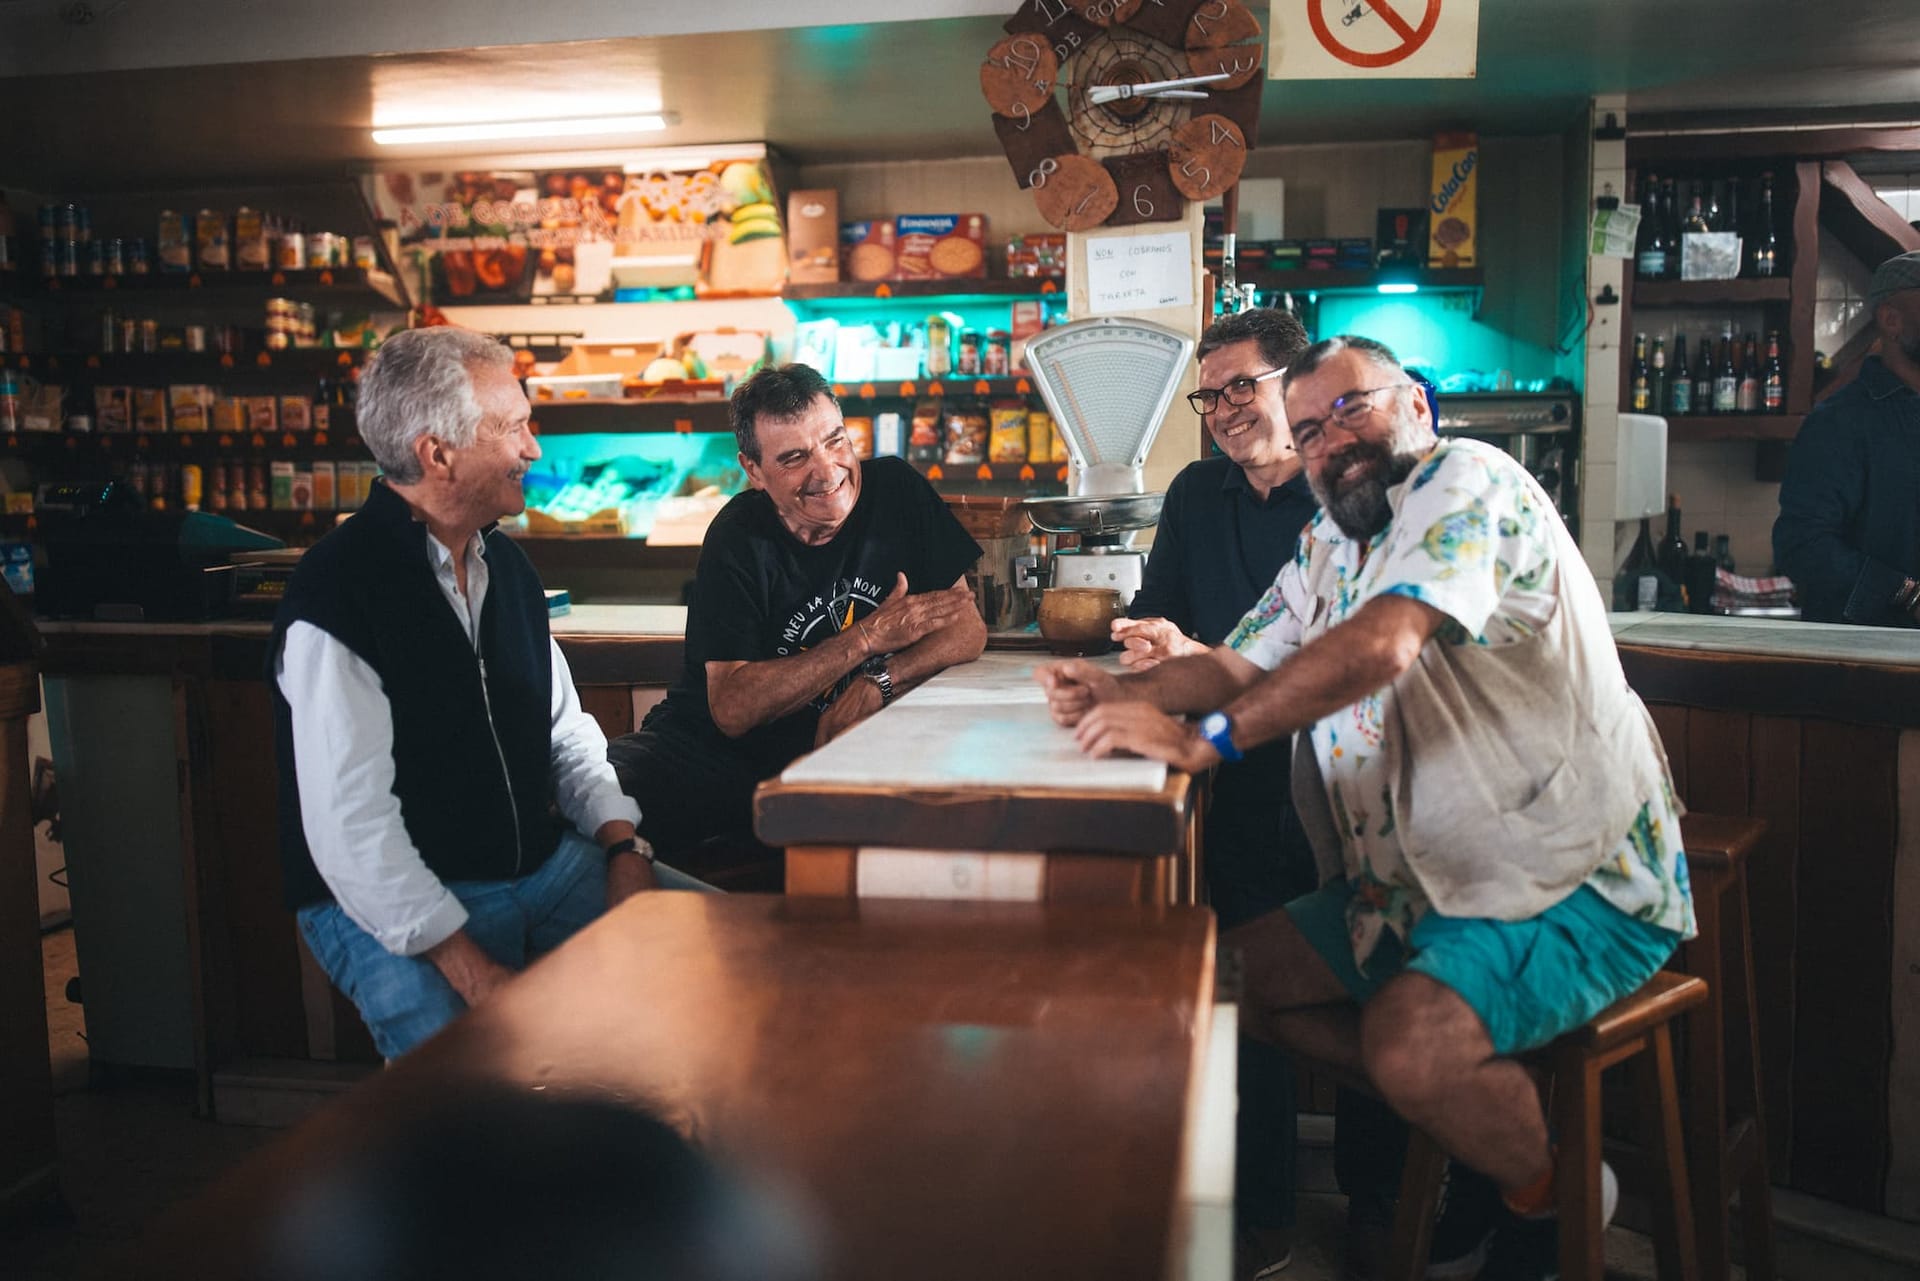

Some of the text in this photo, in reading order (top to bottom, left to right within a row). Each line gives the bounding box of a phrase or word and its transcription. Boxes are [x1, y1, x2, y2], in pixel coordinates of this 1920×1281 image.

[1003, 39, 1040, 80] 10
[1055, 31, 1081, 61] DE
[1011, 102, 1031, 131] 9
[1211, 120, 1240, 147] 4
[1029, 158, 1057, 189] 8
[1182, 158, 1211, 190] 5
[1134, 184, 1155, 217] 6
[1095, 249, 1114, 257] NON
[777, 646, 788, 656] O
[783, 611, 806, 643] MEU
[853, 577, 882, 598] NON
